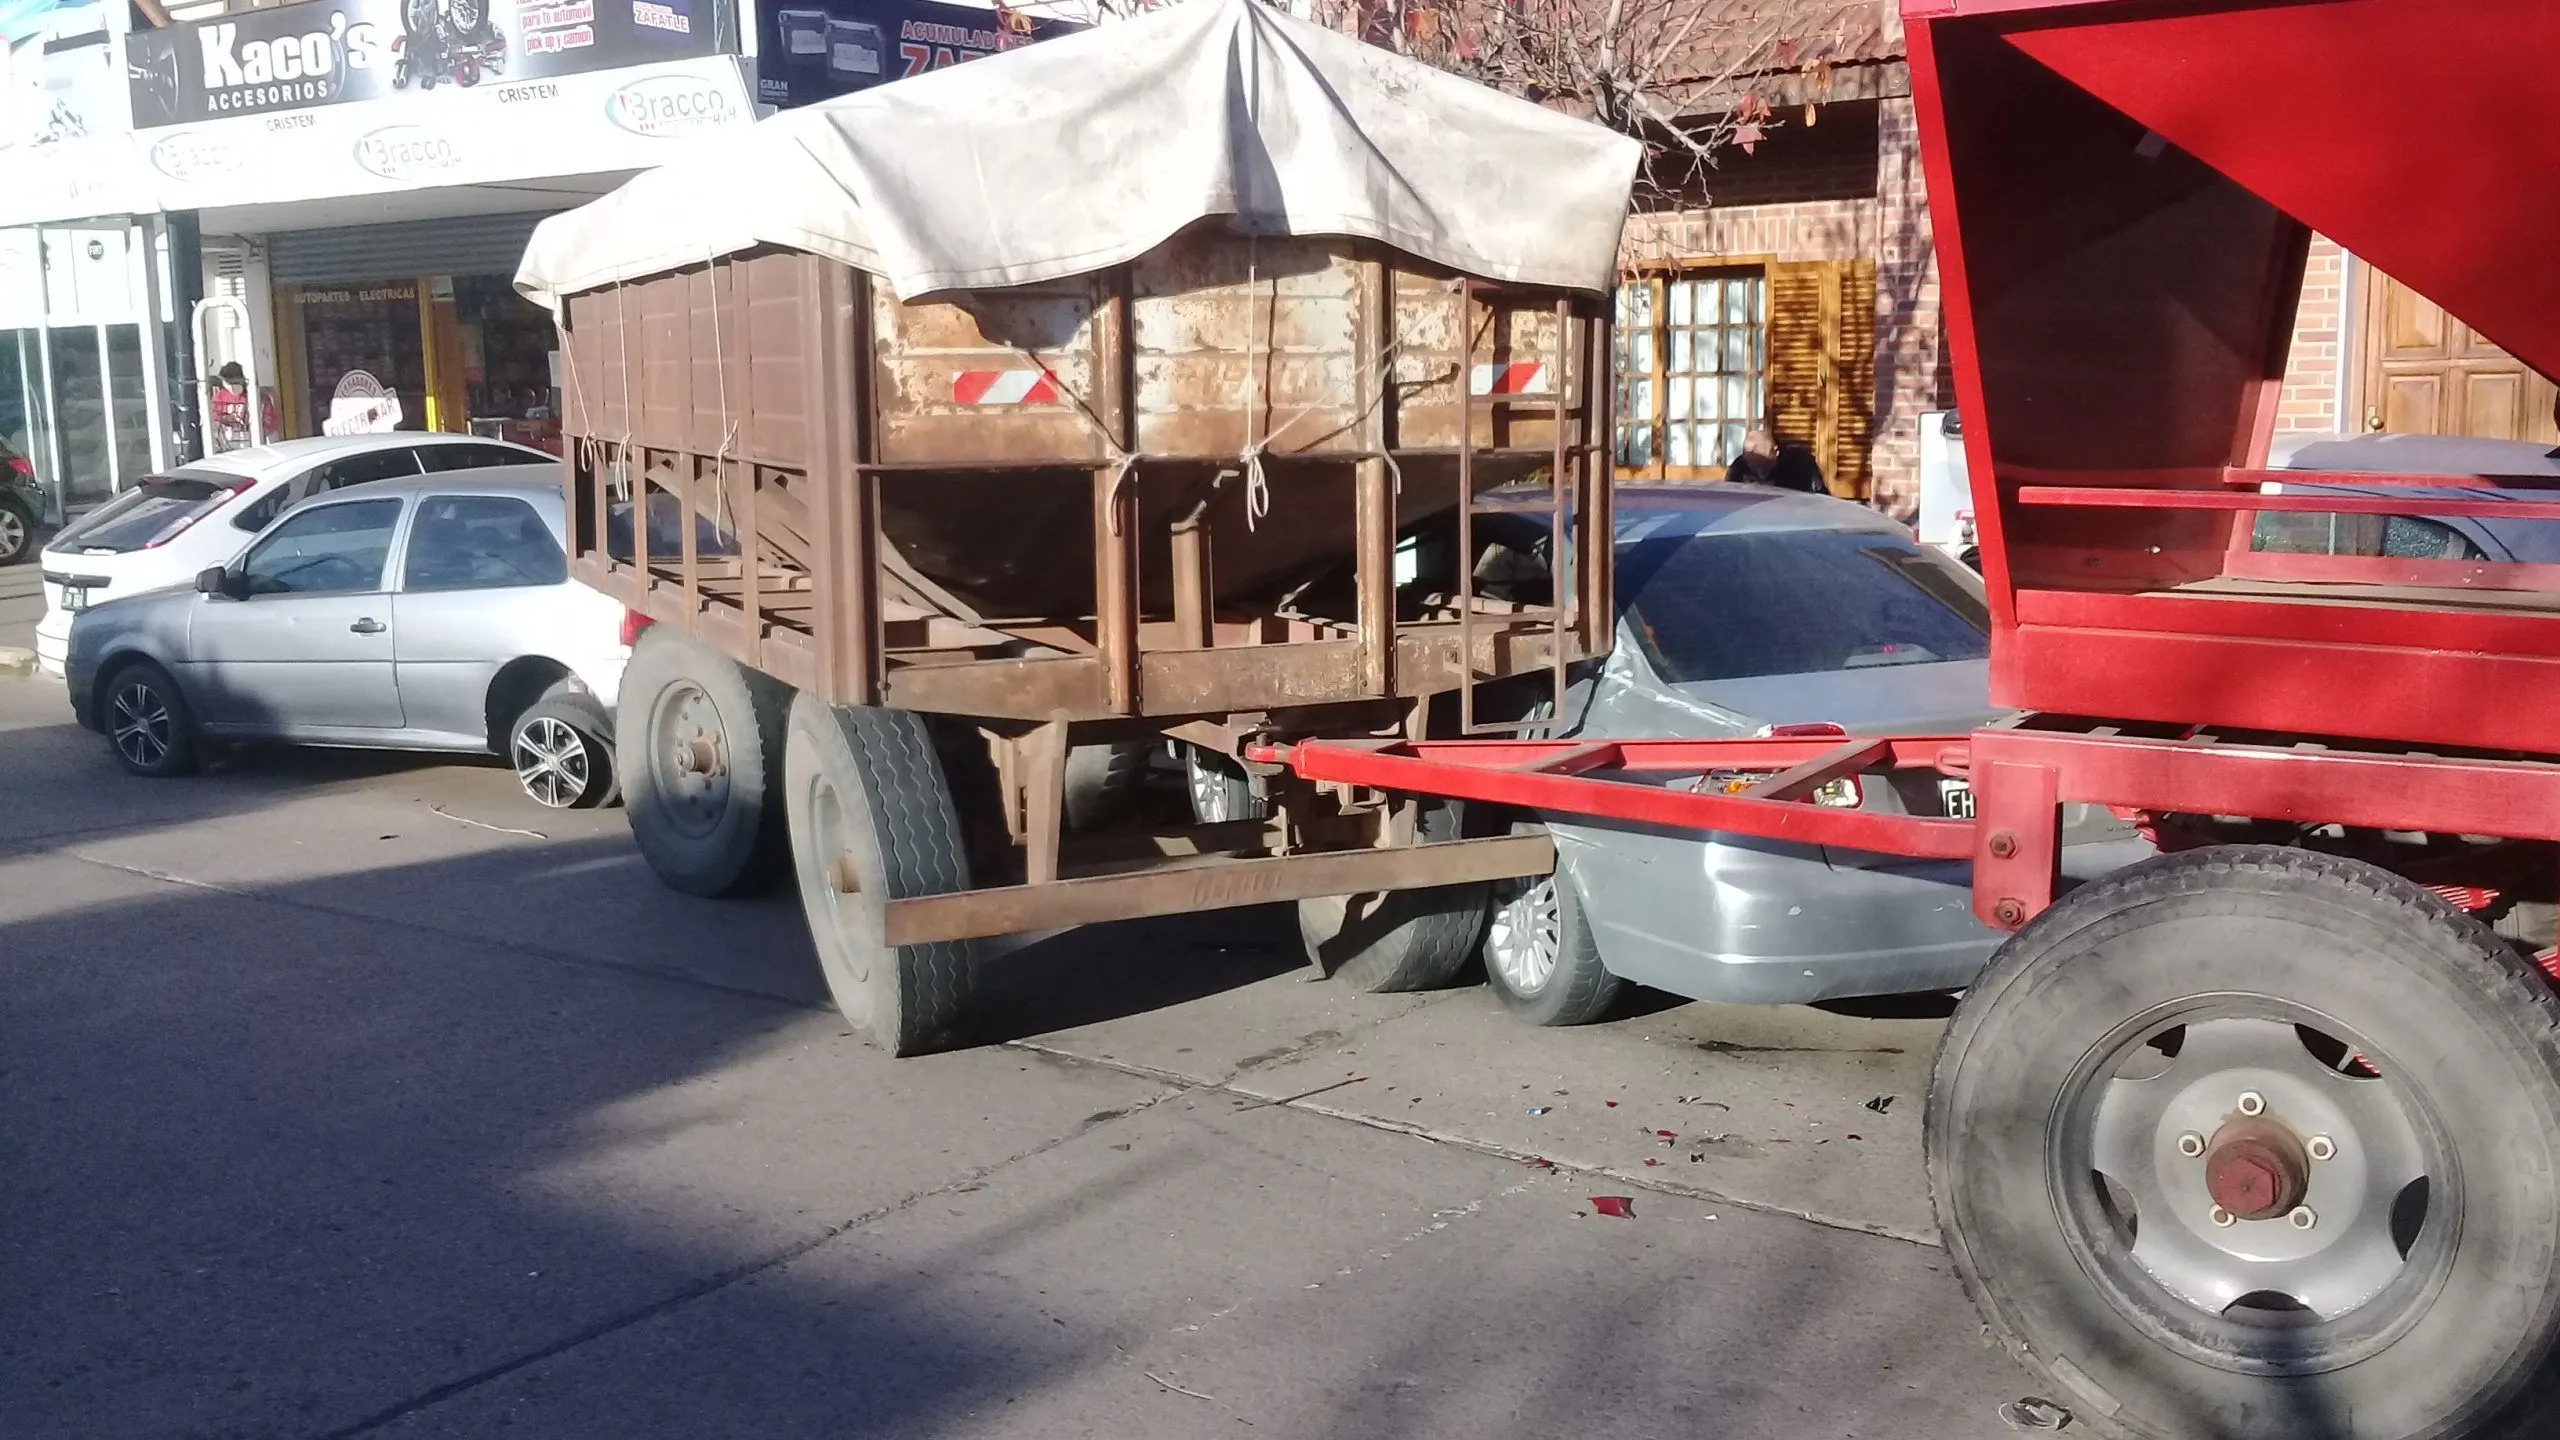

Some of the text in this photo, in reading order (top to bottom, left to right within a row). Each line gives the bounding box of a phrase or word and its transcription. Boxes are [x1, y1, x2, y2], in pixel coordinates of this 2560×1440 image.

[198, 11, 377, 89] Kaco's
[498, 83, 559, 103] CRISTEM
[760, 78, 788, 91] GRAN
[208, 80, 329, 112] ACCESORIOS
[265, 114, 316, 132] CRISTEM
[359, 287, 416, 302] ELECTRICAS
